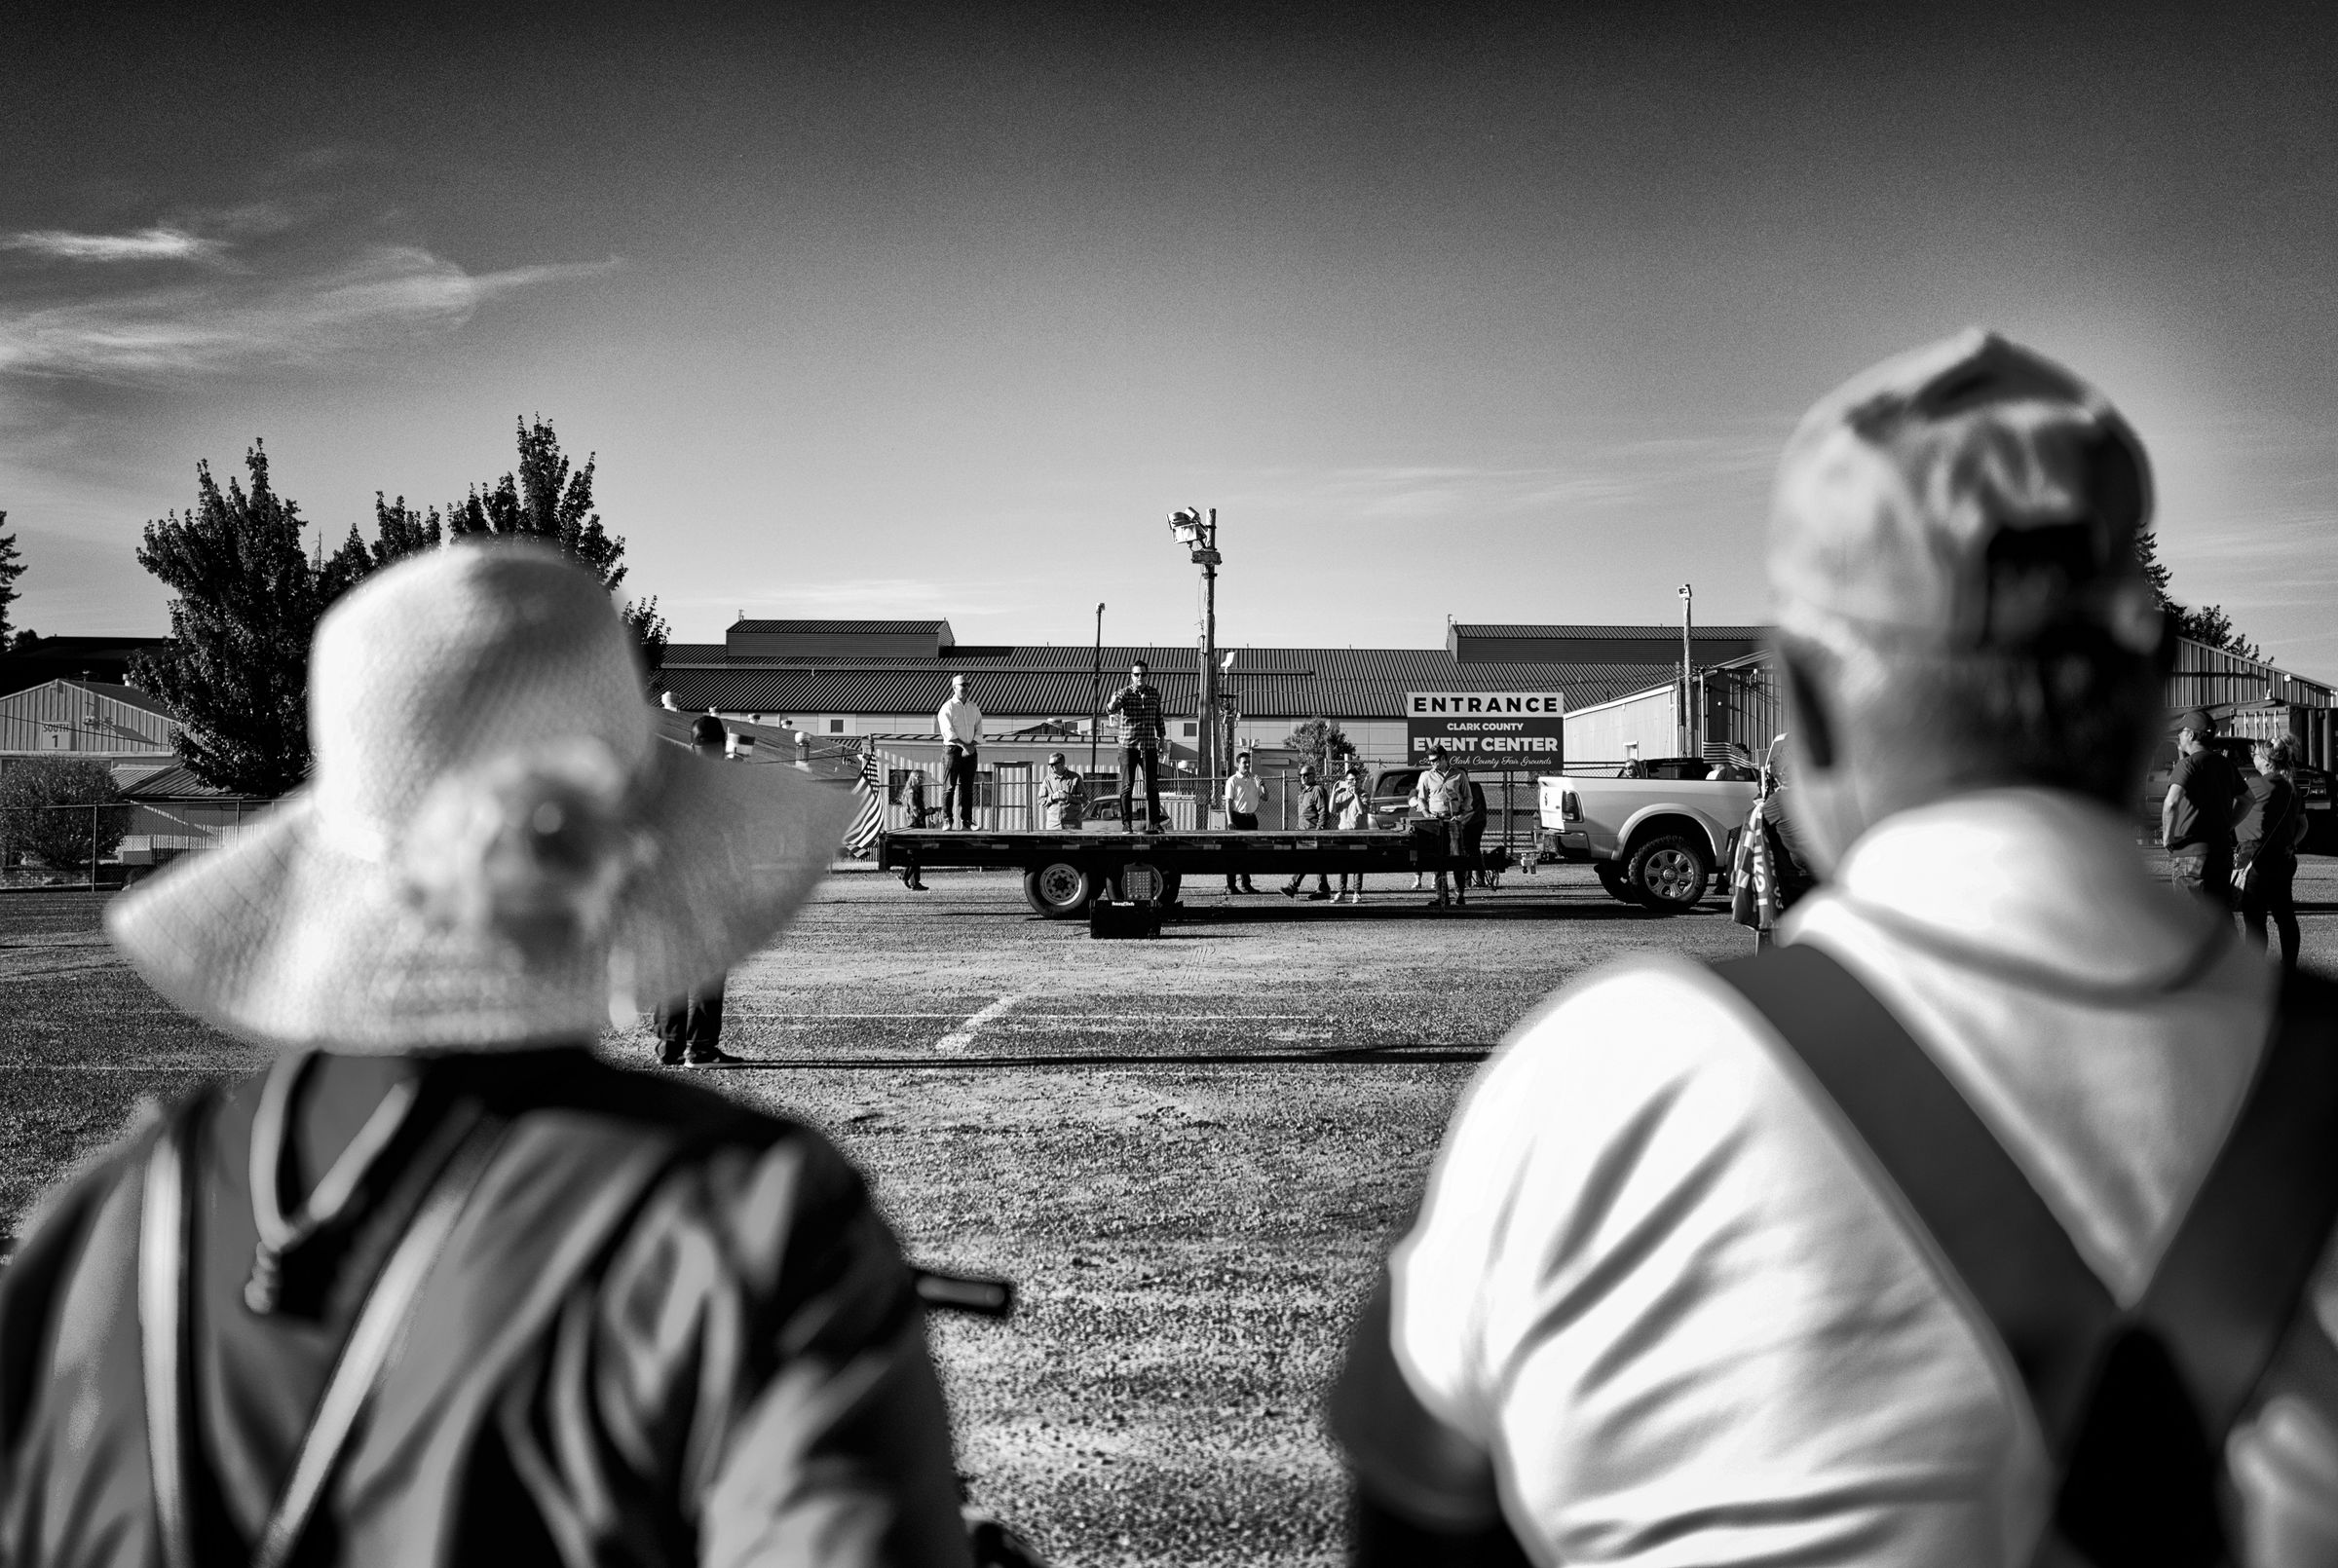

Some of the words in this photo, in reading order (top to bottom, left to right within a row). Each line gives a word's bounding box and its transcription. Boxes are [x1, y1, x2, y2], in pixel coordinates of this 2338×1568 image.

[1414, 697, 1558, 713] ENTRANCE
[43, 724, 69, 732] SOUTH
[1447, 723, 1481, 731] CLARK
[1482, 723, 1525, 731] COUNTY
[52, 734, 58, 748] 1
[1414, 737, 1478, 752] EVENT
[1481, 737, 1558, 752] CENTER
[1449, 756, 1470, 765] Clark
[1473, 756, 1499, 768] County
[1501, 756, 1519, 765] Fair
[1520, 756, 1552, 766] Grounds
